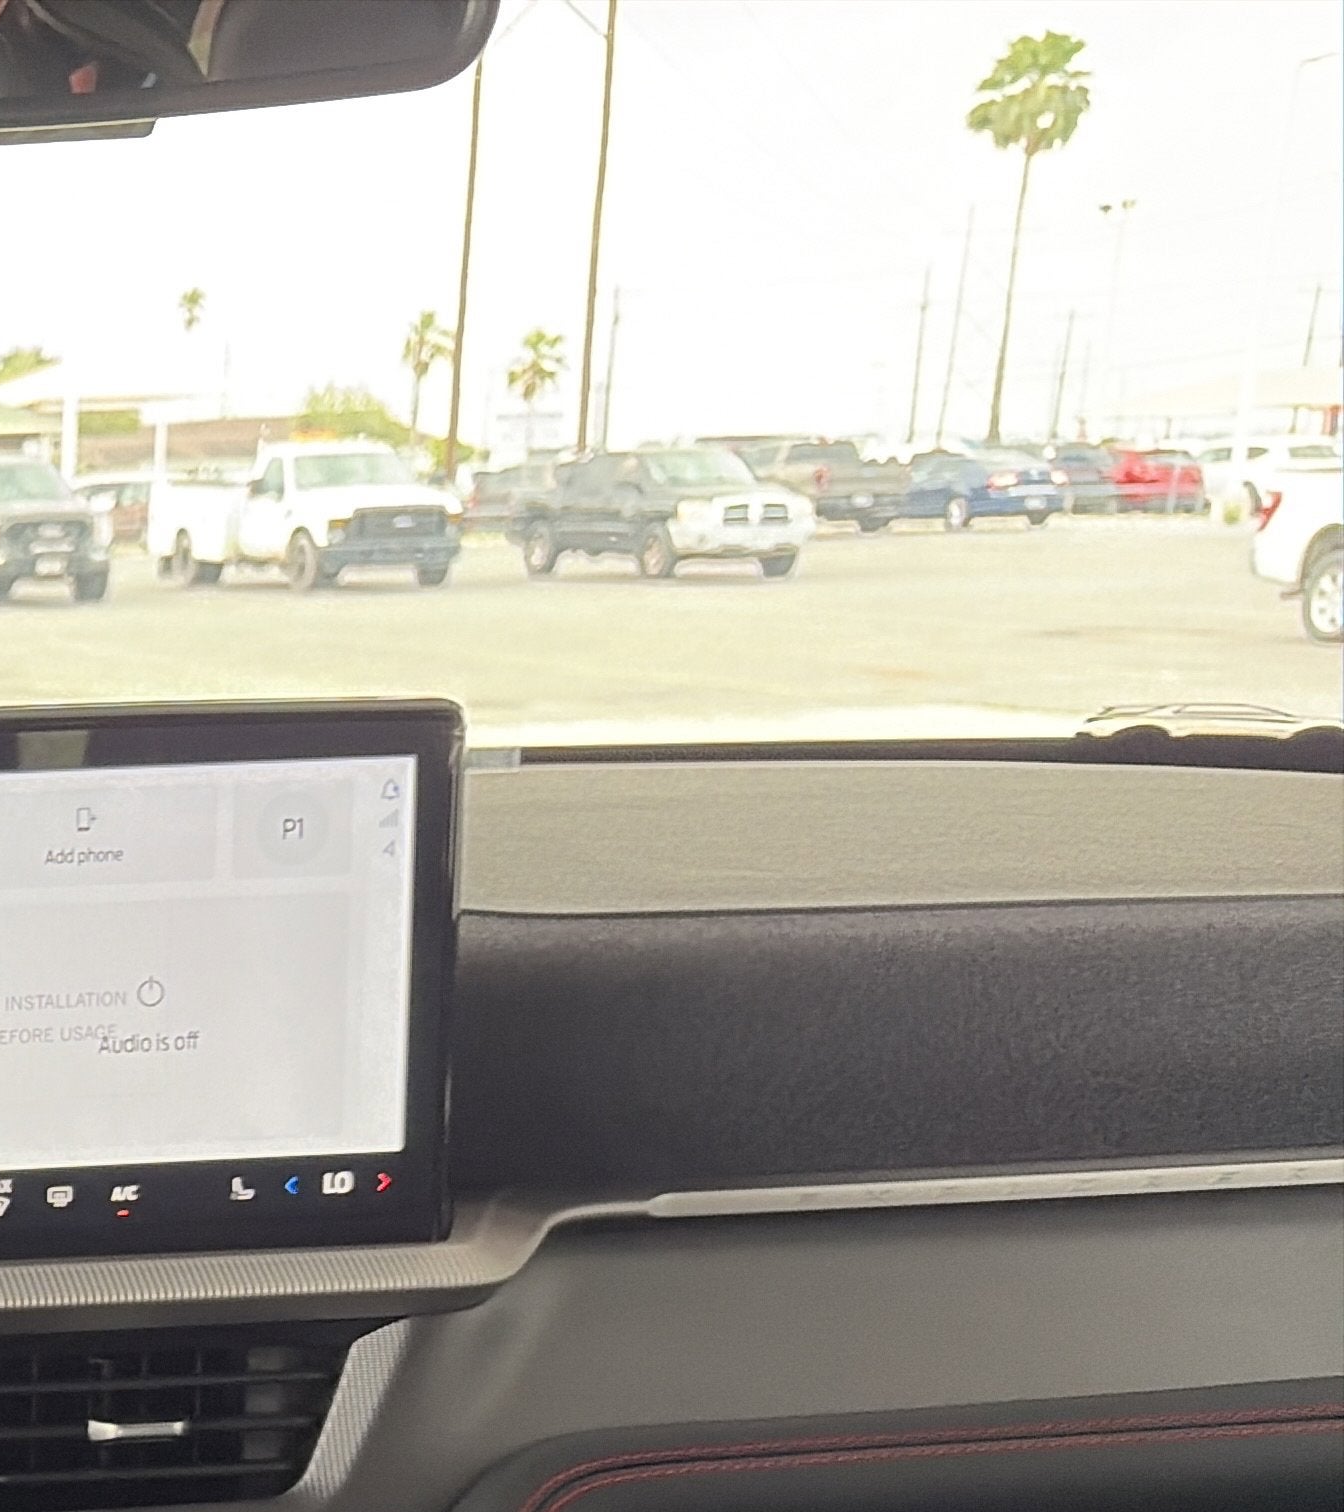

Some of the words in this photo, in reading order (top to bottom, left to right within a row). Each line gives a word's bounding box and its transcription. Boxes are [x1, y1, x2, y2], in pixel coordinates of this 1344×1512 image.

[282, 818, 304, 840] P1
[45, 849, 74, 864] Add
[77, 847, 124, 865] phone
[4, 991, 127, 1011] INSTALLATION
[60, 1024, 117, 1041] USAGE
[98, 1033, 152, 1053] Audio
[156, 1033, 170, 1051] is
[175, 1031, 200, 1051] off
[322, 1170, 356, 1194] LO
